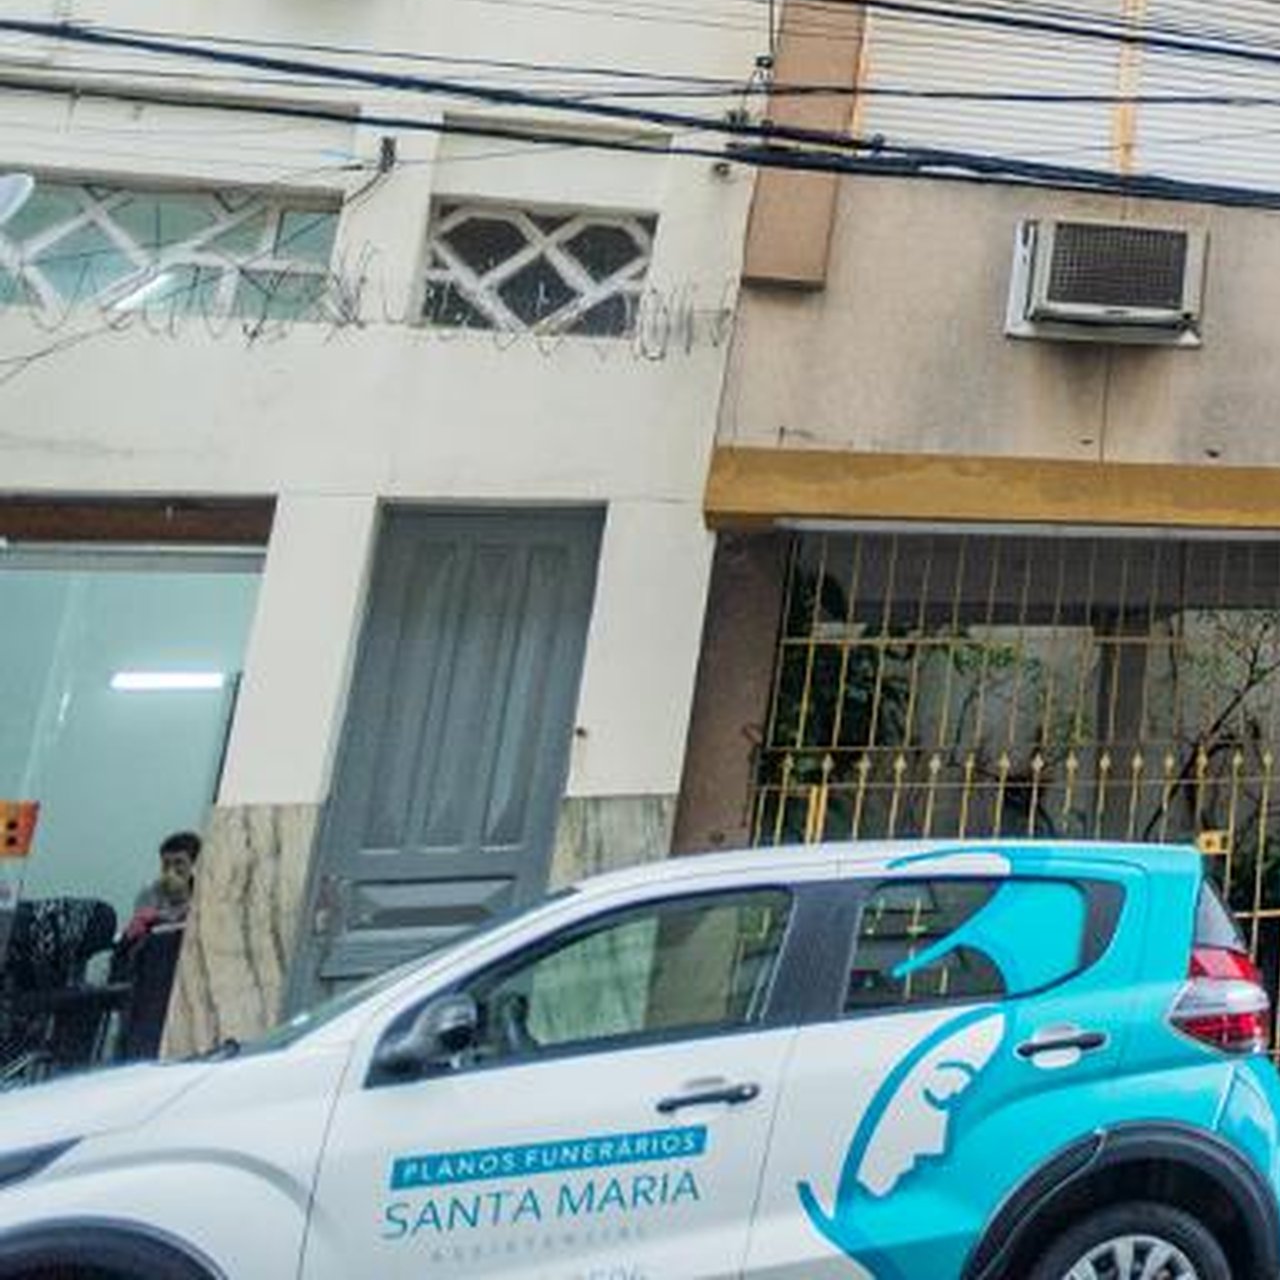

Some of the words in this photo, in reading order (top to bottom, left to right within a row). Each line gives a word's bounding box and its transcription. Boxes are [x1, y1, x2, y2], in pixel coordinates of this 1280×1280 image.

[402, 1152, 516, 1181] PLANOS
[385, 1188, 541, 1239] SANTA
[557, 1170, 700, 1216] MARIA
